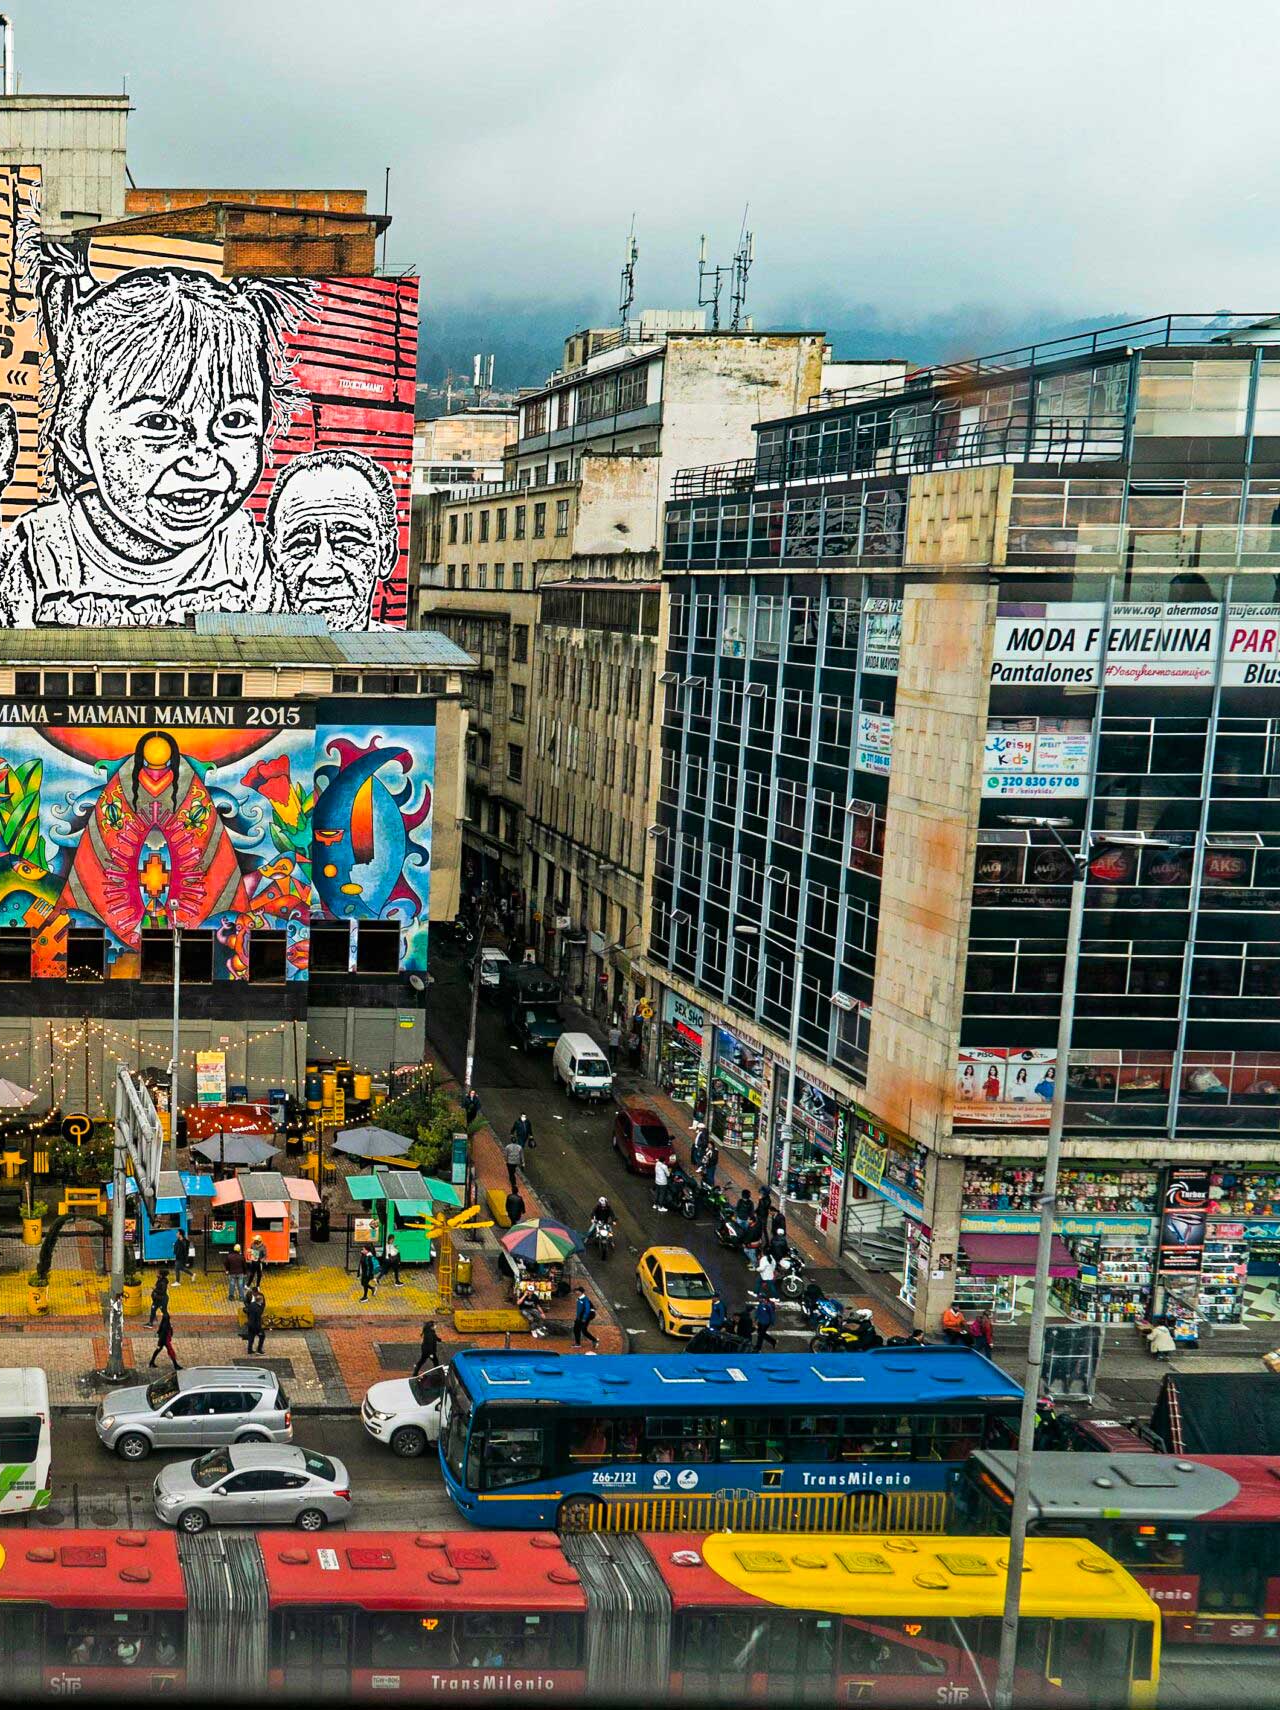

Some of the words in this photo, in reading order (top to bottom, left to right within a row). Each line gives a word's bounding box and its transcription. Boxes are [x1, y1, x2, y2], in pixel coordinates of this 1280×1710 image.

[1006, 628, 1077, 652] MODA
[1229, 628, 1280, 653] PAR
[990, 662, 1094, 683] Pantalones
[67, 705, 147, 724] MAMANI
[154, 704, 235, 725] MAMANI
[245, 705, 301, 726] 2015
[985, 737, 1032, 753] Keisy
[1001, 776, 1023, 787] 320
[1025, 777, 1047, 787] 830
[1049, 777, 1063, 787] 67
[1064, 777, 1080, 787] 08
[1209, 858, 1241, 872] AKS
[674, 1001, 687, 1018] SEX
[1181, 1190, 1206, 1198] Turbox
[592, 1471, 637, 1482] Z66-7121
[802, 1471, 911, 1486] TransMilenio
[431, 1674, 555, 1692] TransMilenio
